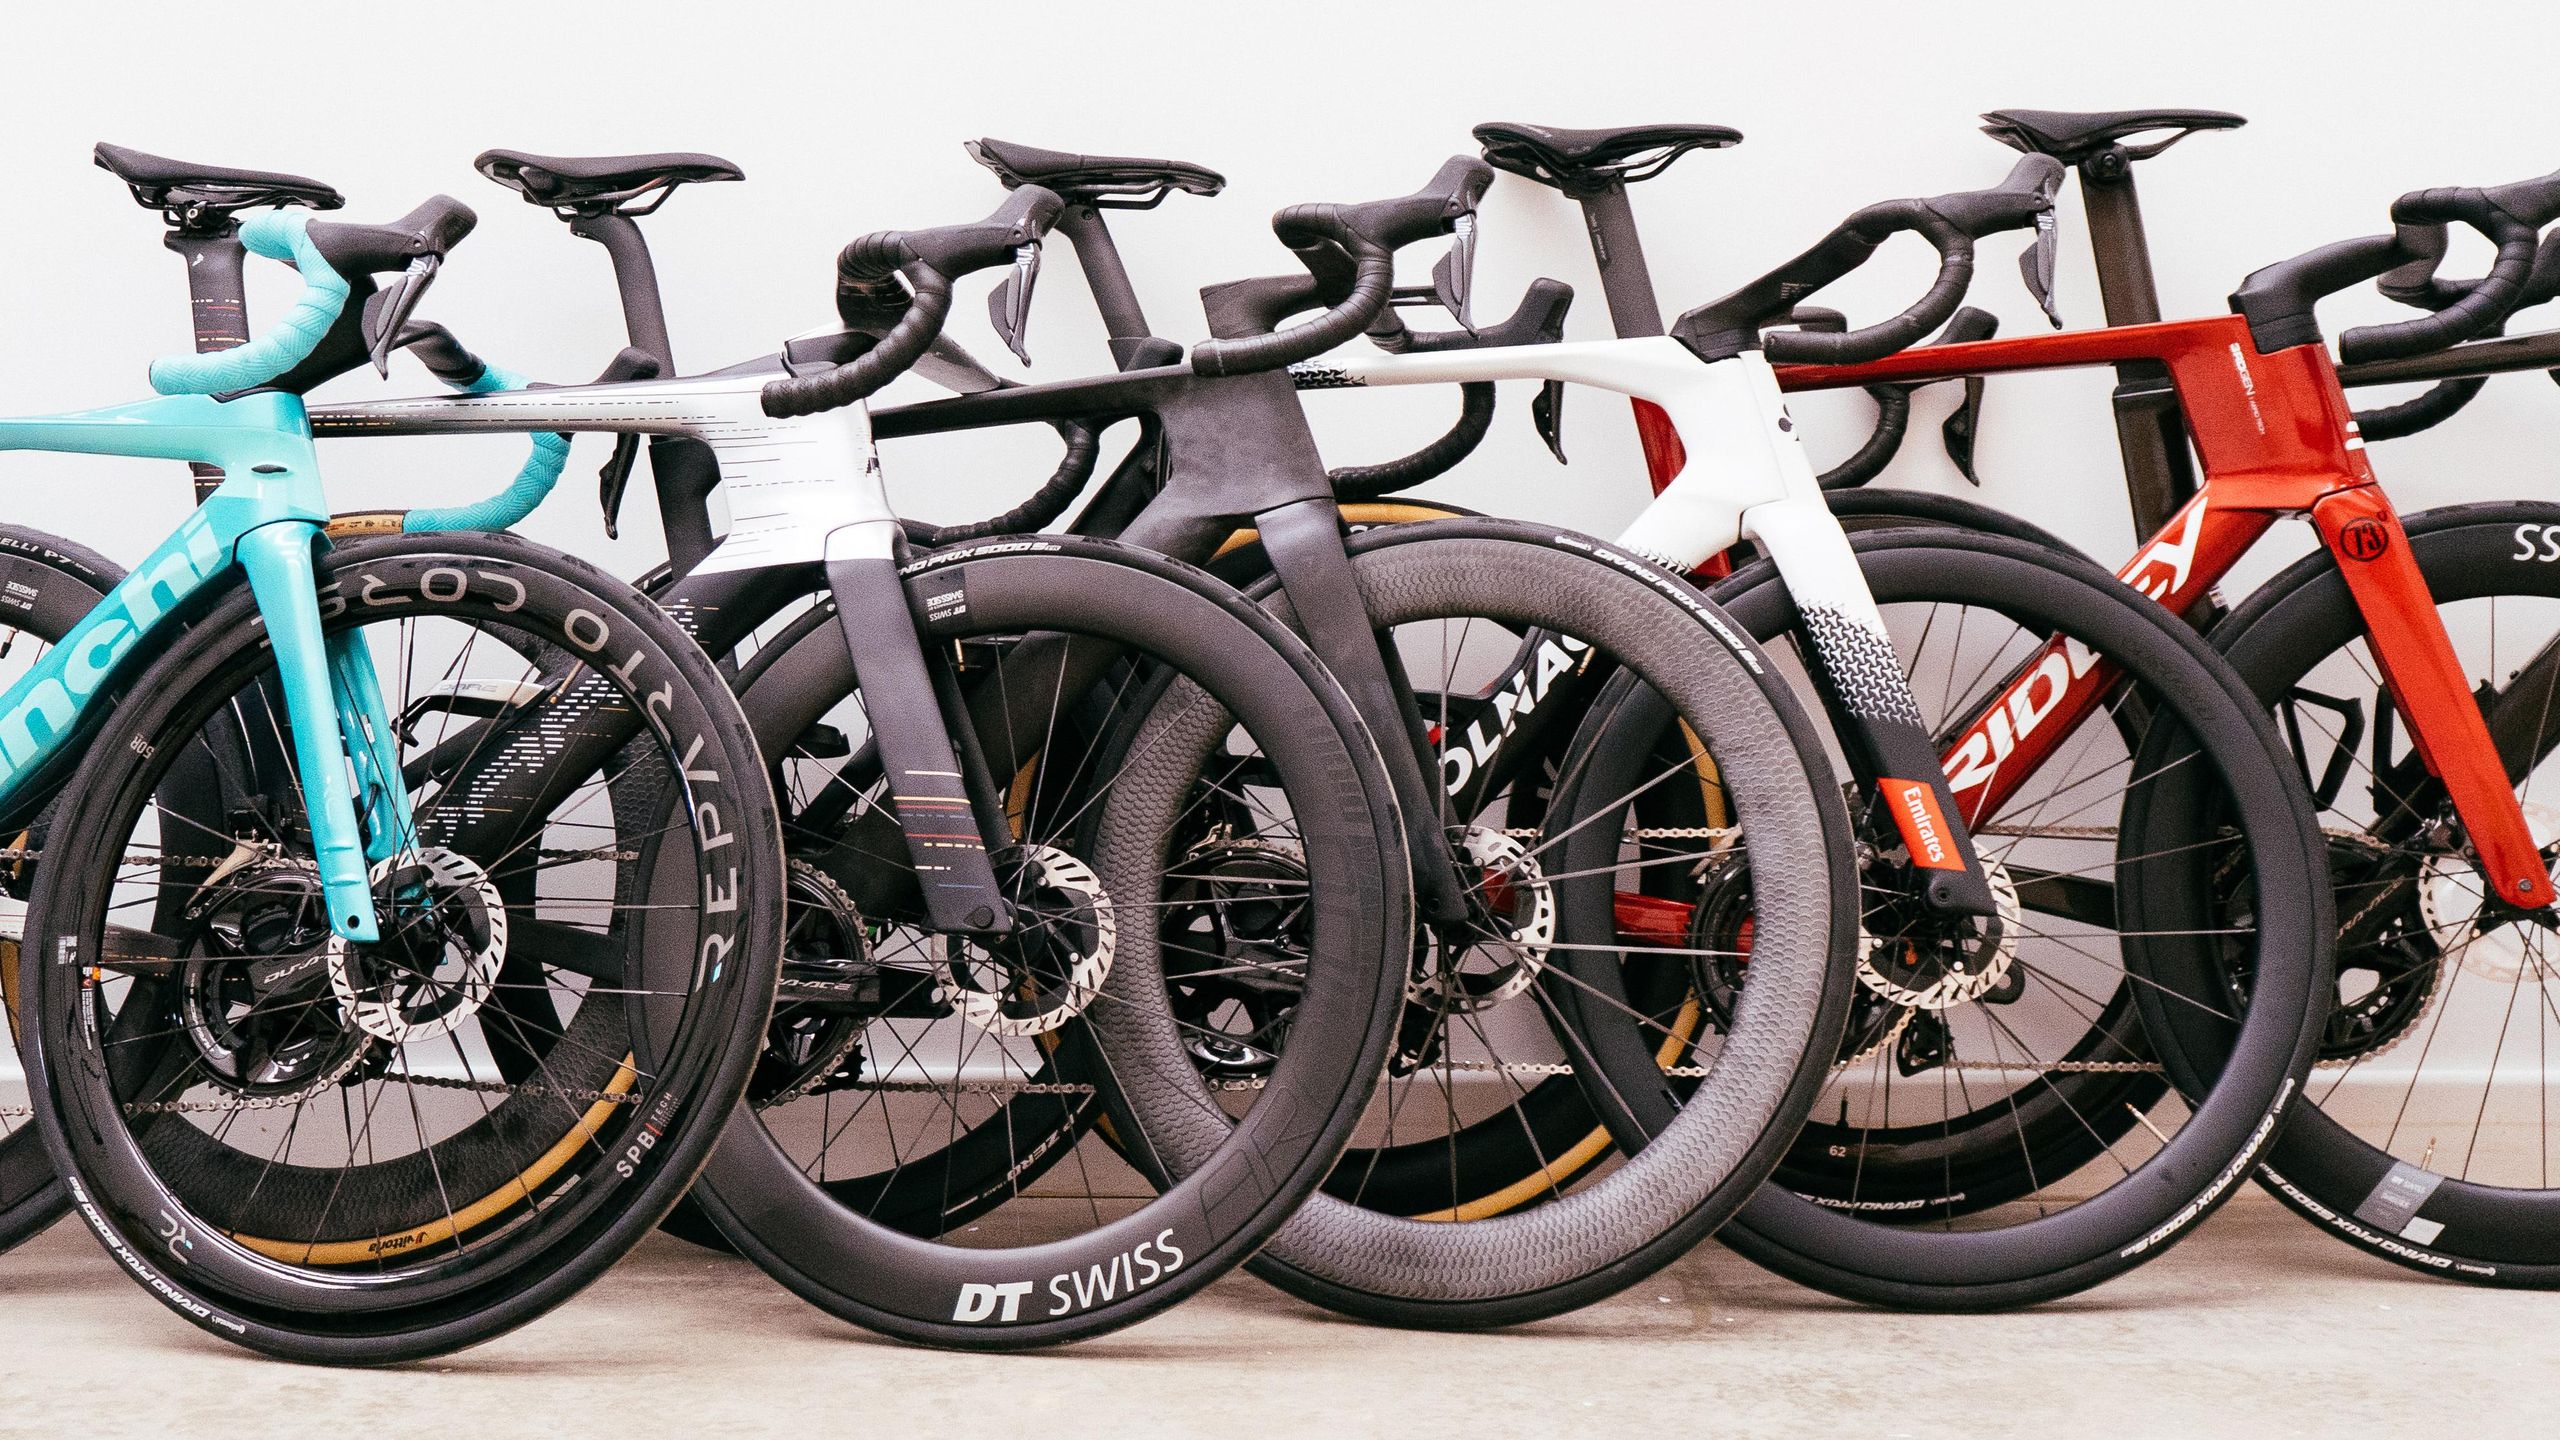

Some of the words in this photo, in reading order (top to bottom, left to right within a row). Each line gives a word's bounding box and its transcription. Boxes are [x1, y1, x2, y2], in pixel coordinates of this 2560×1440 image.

[0, 537, 39, 552] ELLI
[898, 560, 928, 576] ND
[927, 548, 975, 567] PRIX
[974, 542, 1033, 556] 5000
[1, 595, 21, 607] SWISS
[929, 608, 952, 622] SWISS
[953, 604, 966, 615] DT
[1594, 549, 1661, 583] GRAND
[1655, 579, 1702, 610] PRIX
[1696, 608, 1746, 650] 5000
[0, 509, 222, 785] nchi
[1438, 634, 1589, 797] OLNA
[129, 733, 155, 760] 50R
[1903, 786, 1945, 863] Emirates
[263, 955, 329, 985] DURA-
[616, 1131, 656, 1178] SPB
[651, 1092, 672, 1122] TECH
[1829, 1145, 1847, 1158] 62
[2232, 1114, 2275, 1176] GRAND
[1007, 1129, 1060, 1181] ZERO
[1858, 1199, 1926, 1211] GRAND
[2198, 1170, 2234, 1211] PRIX
[2281, 1184, 2337, 1221] 5000
[82, 1203, 122, 1248] 5000
[2150, 1204, 2197, 1245] 5000
[2332, 1217, 2384, 1245] PRIX
[116, 1246, 156, 1281] PRIX
[2379, 1239, 2453, 1269] GRAND
[952, 1281, 1034, 1322] DT
[1049, 1228, 1184, 1316] SWISS
[151, 1278, 211, 1318] GRAND
